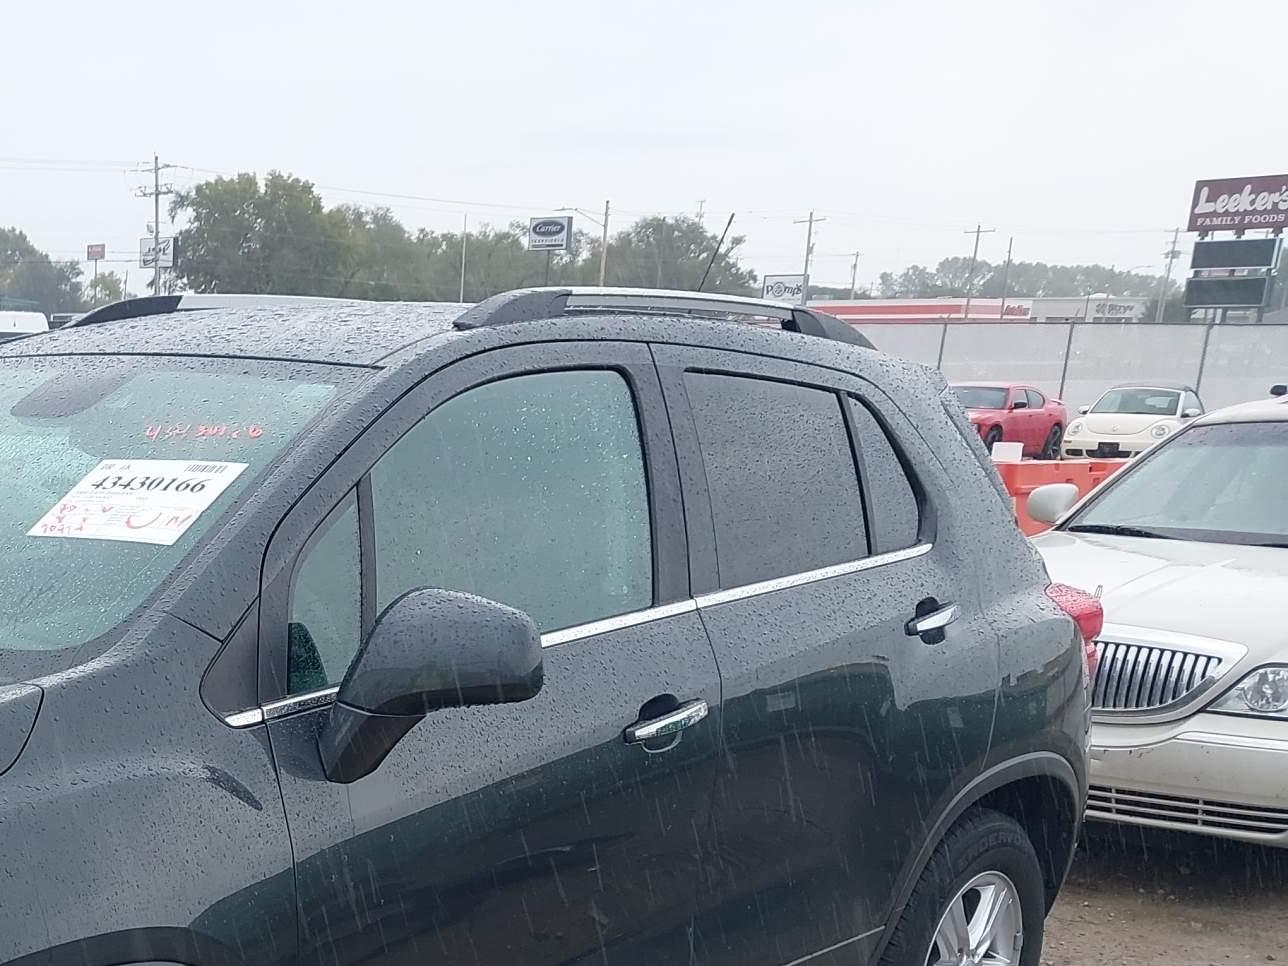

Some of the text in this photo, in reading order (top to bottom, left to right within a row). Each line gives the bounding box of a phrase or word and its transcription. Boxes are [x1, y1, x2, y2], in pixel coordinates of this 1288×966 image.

[1194, 184, 1288, 214] Leeker's
[1196, 213, 1286, 226] FAMILY FOODS
[536, 223, 562, 233] Carrier
[91, 475, 213, 493] 43430166
